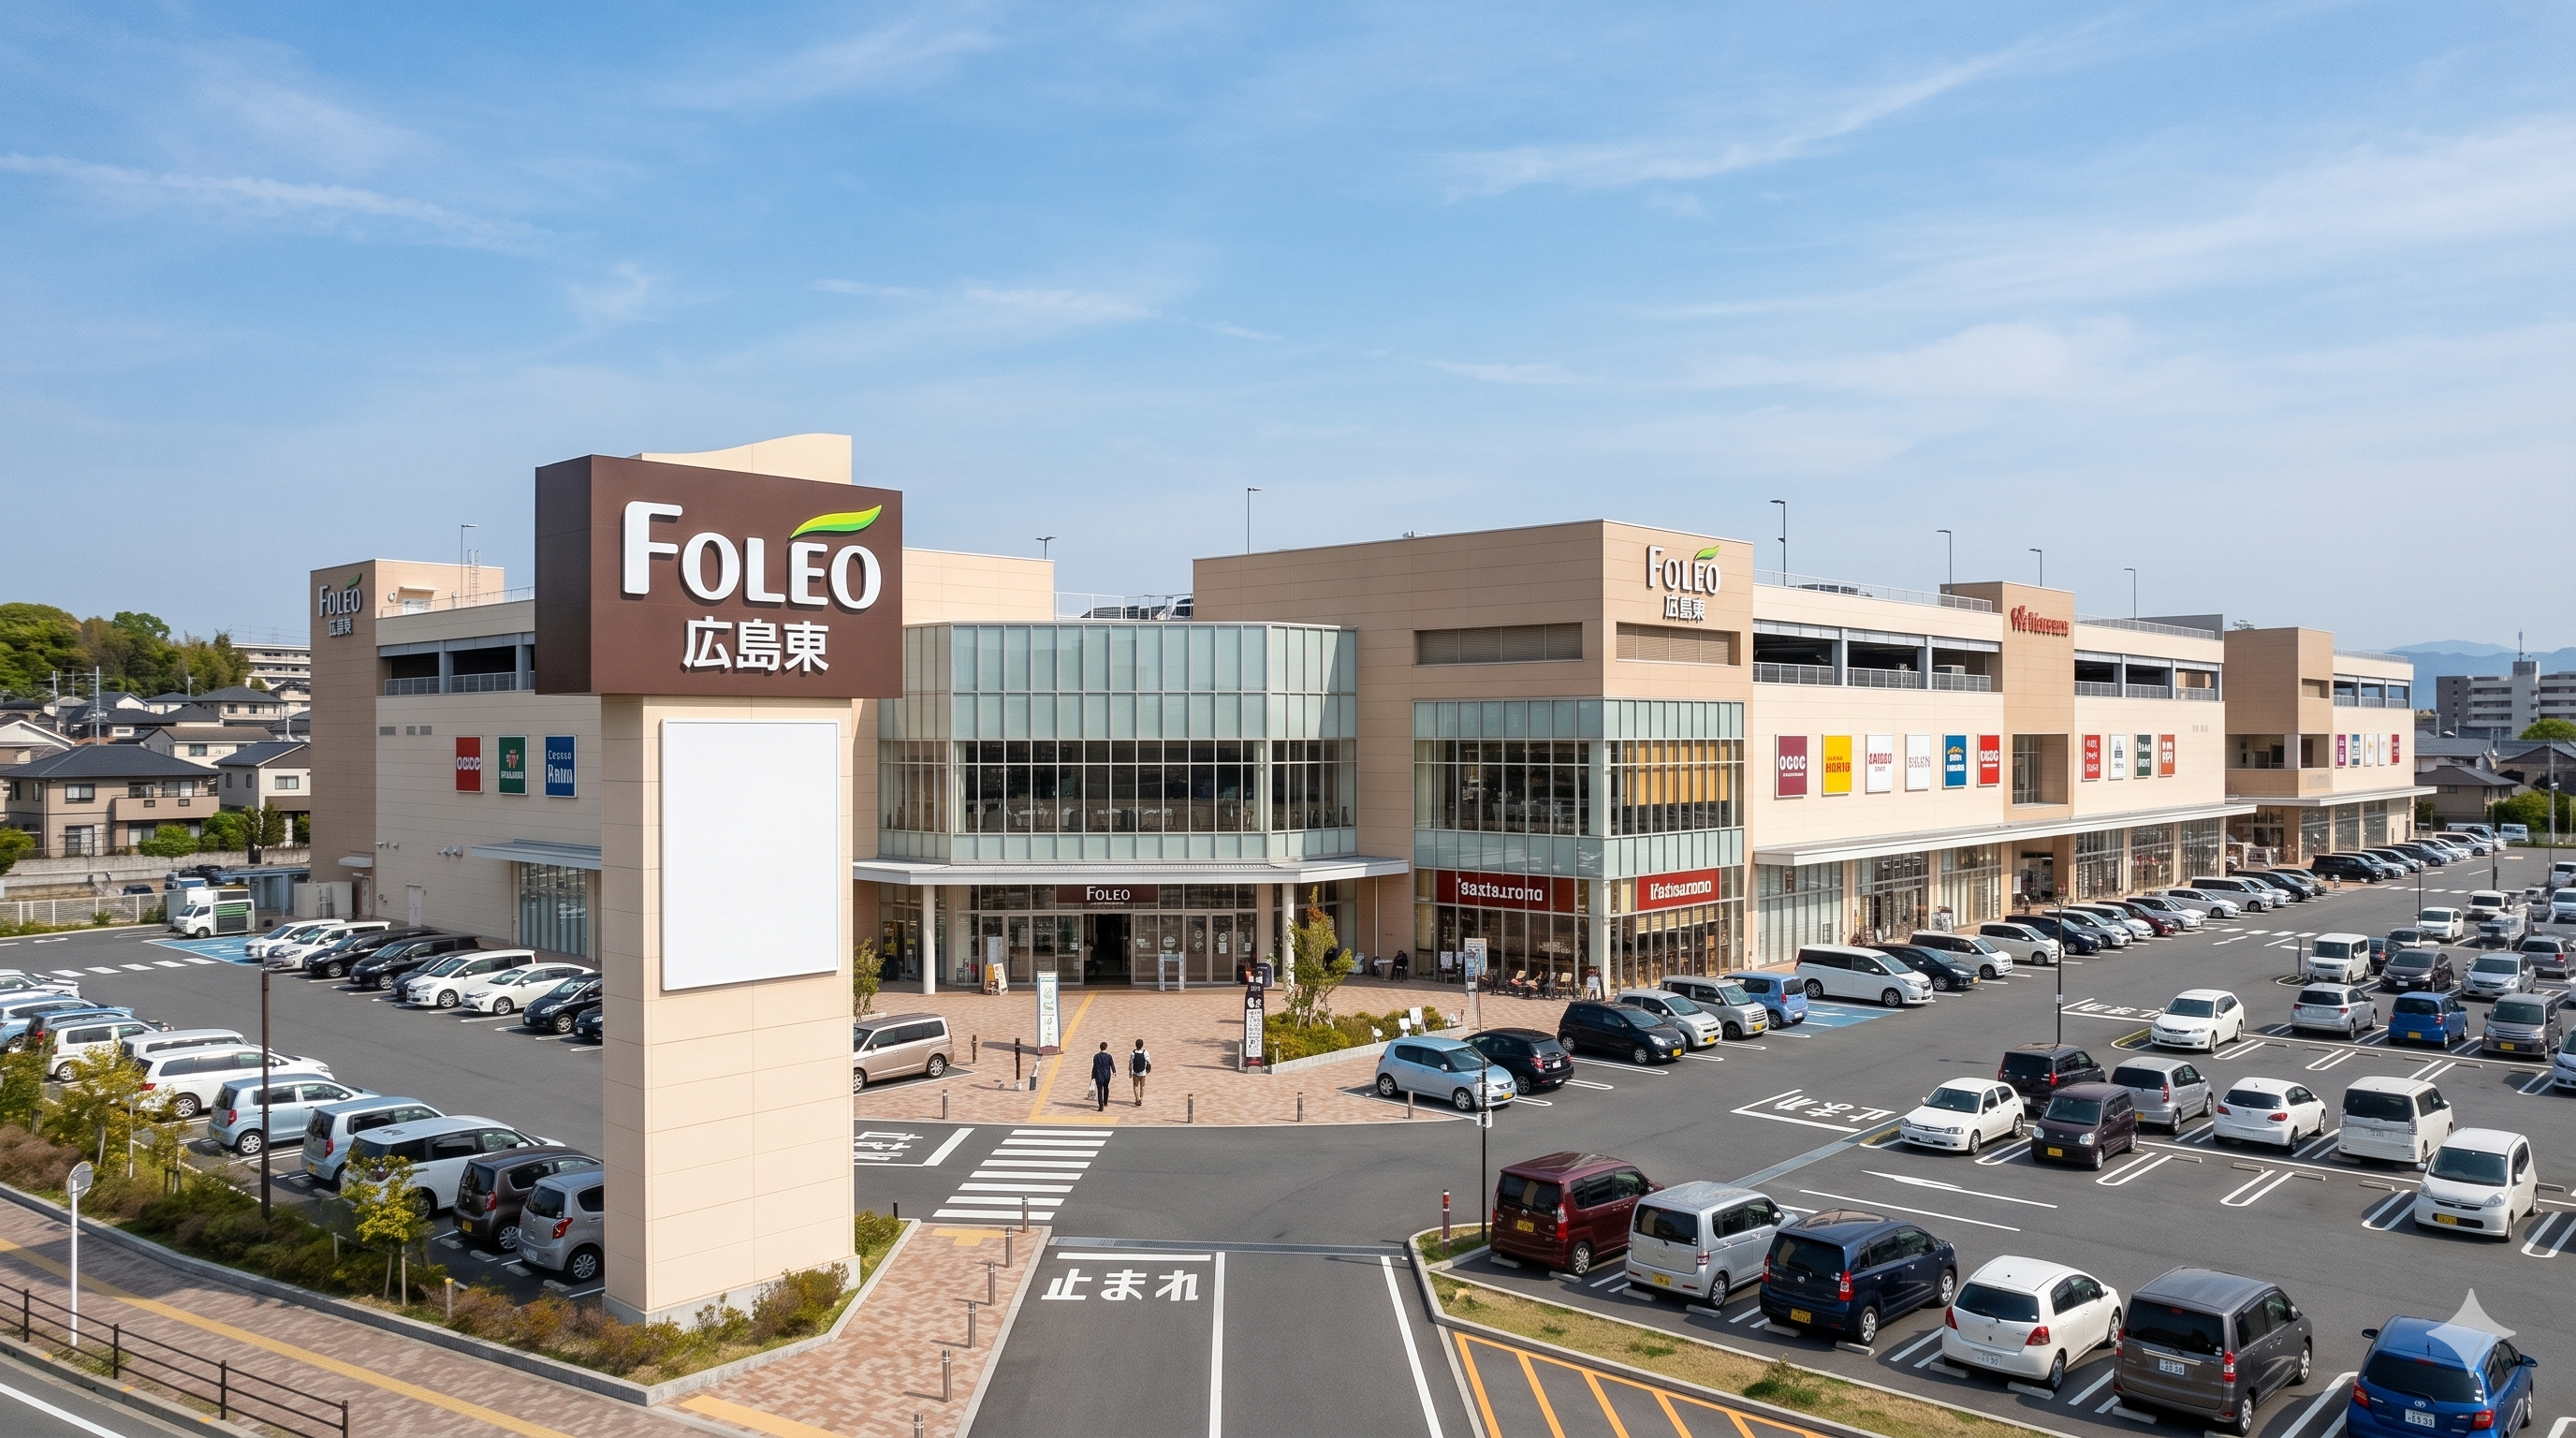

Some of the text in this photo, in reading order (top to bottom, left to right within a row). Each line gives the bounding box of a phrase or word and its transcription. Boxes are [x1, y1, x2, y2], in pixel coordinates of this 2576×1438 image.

[623, 500, 883, 609] FOLEO
[1647, 545, 1721, 594] FOLEO
[318, 585, 361, 617] FOLEO
[682, 615, 829, 672] 広島東
[1086, 886, 1131, 901] FOLEO
[1040, 1268, 1200, 1301] 止まれ
